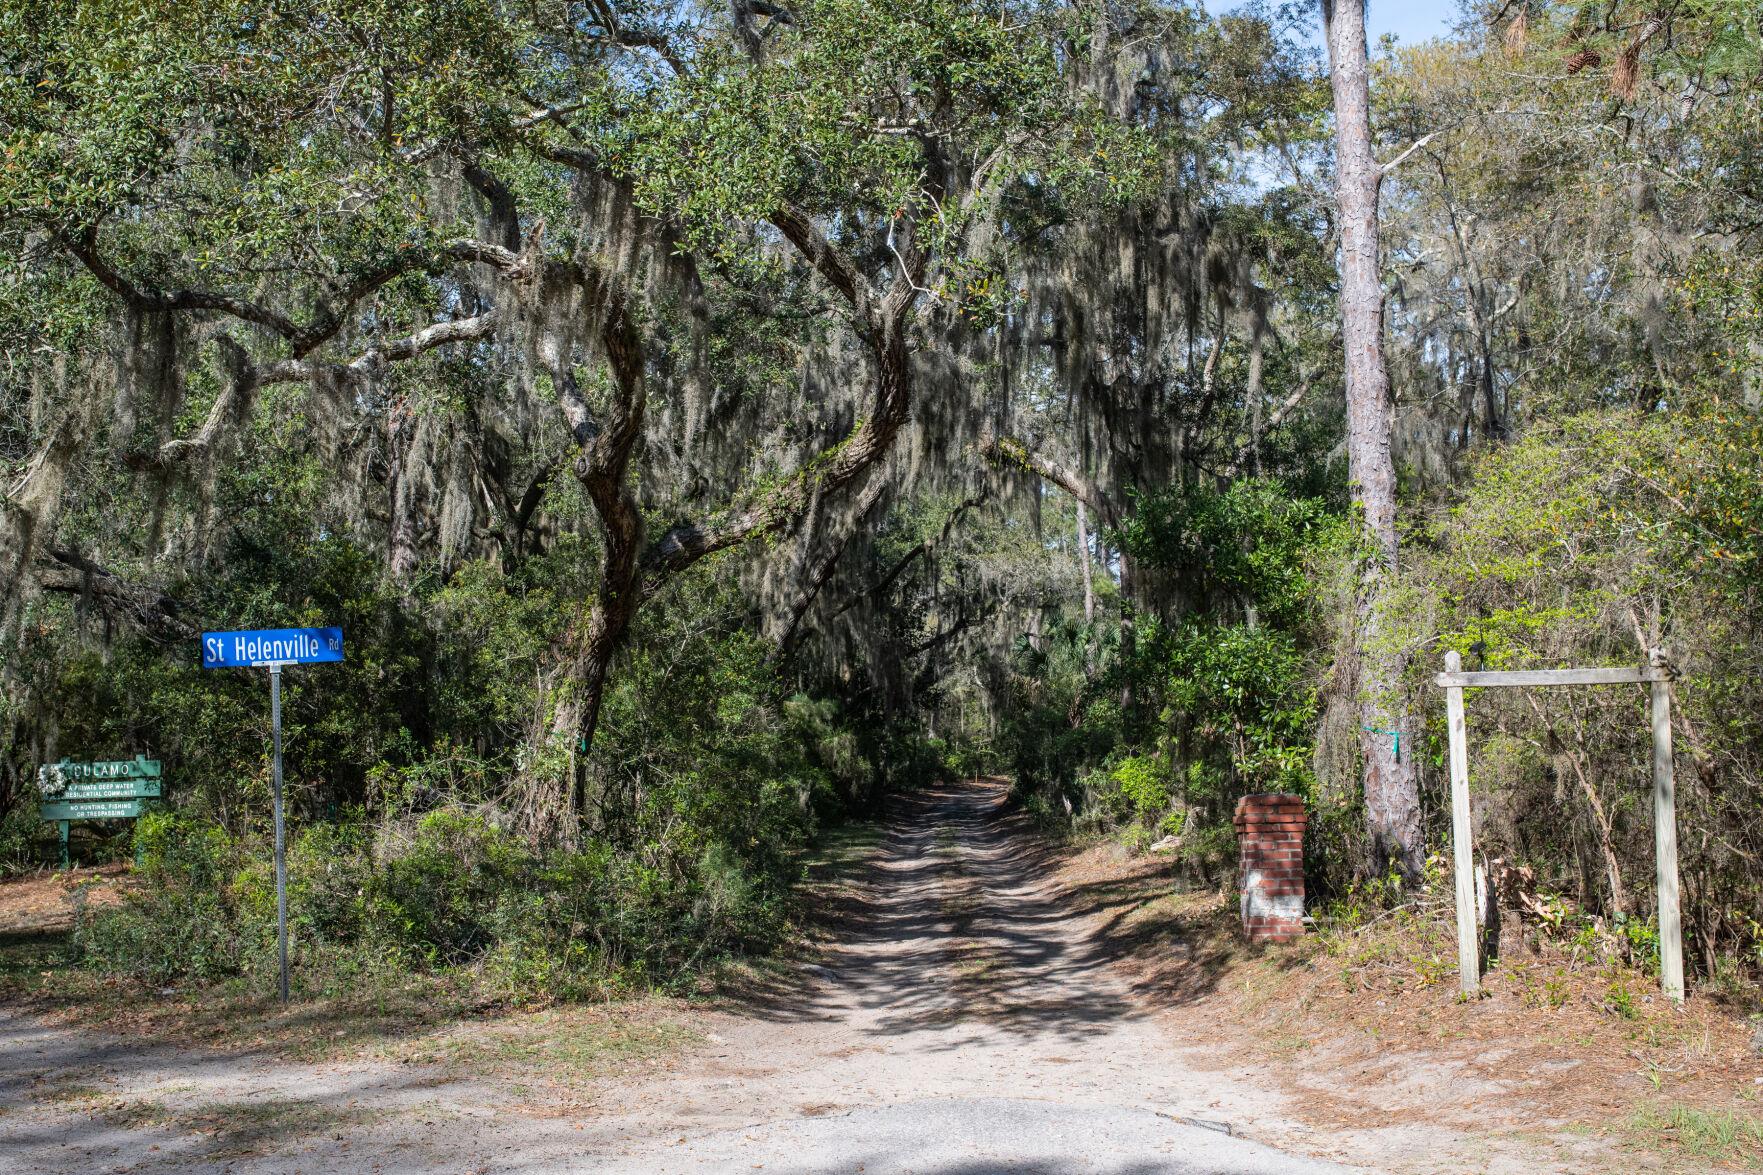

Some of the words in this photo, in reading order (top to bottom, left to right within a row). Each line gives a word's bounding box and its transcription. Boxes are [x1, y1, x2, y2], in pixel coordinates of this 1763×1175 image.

[206, 637, 225, 663] St
[235, 634, 319, 661] Helenville
[329, 638, 340, 651] Rd
